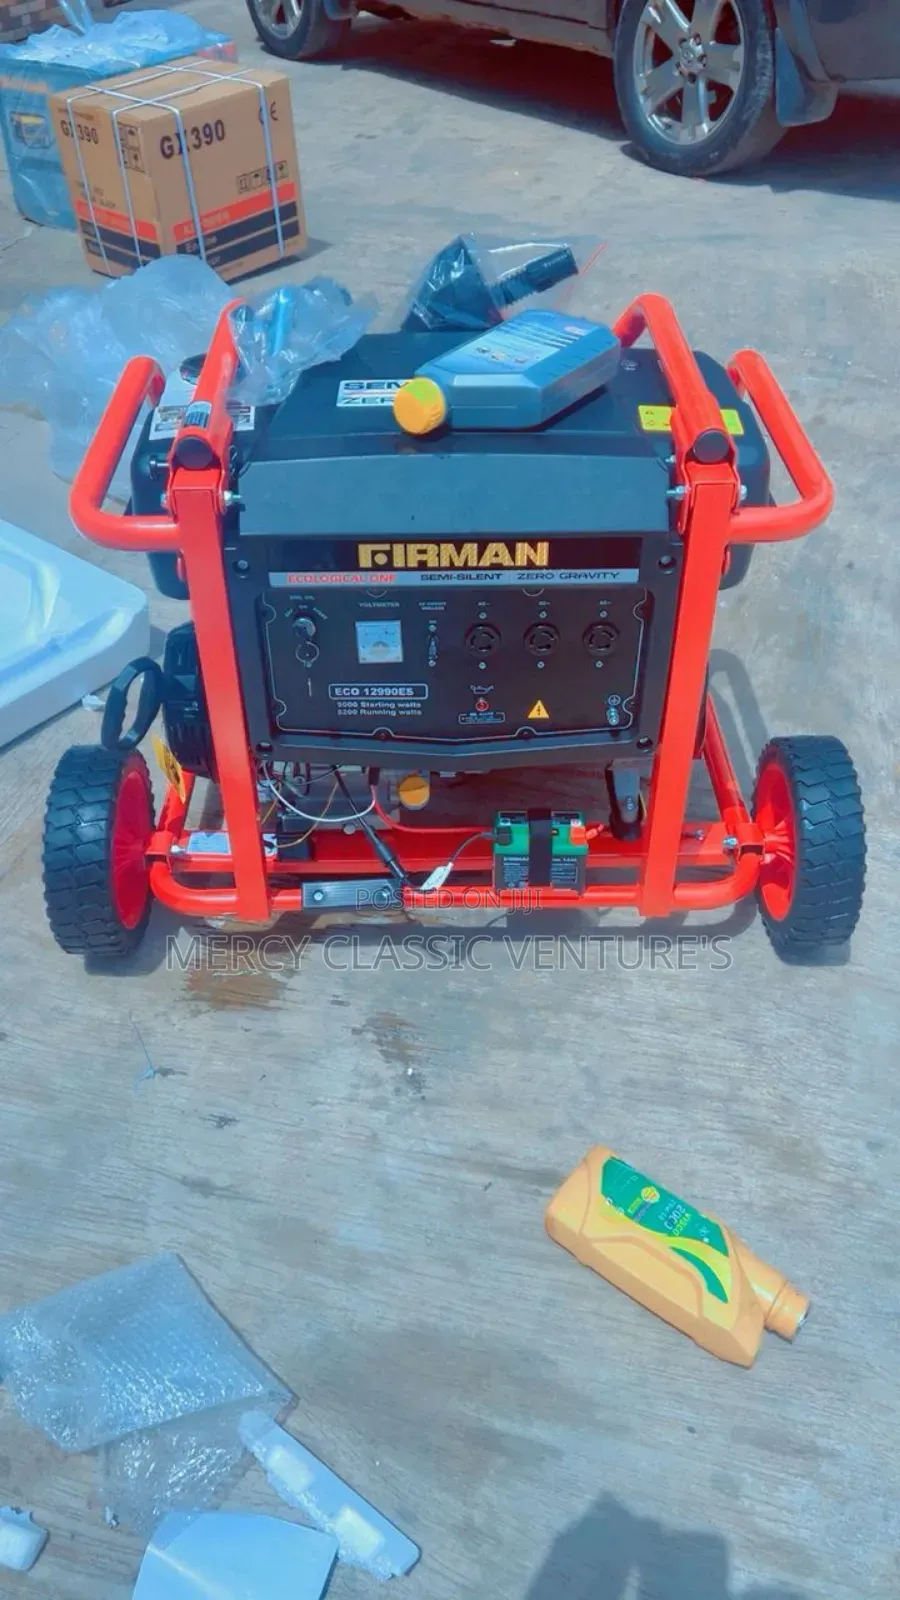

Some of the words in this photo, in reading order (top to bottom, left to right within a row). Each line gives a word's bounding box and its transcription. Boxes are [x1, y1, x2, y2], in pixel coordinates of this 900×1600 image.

[357, 541, 550, 569] FIRMAN
[288, 572, 364, 584] ECOLOGICAL
[420, 572, 504, 581] SEMI-SILENT
[517, 571, 555, 580] ZERO
[559, 570, 620, 580] GRAVITY
[334, 687, 360, 696] ECO
[363, 687, 414, 696] 12990ES
[360, 701, 396, 709] Starting
[360, 709, 396, 717] Running
